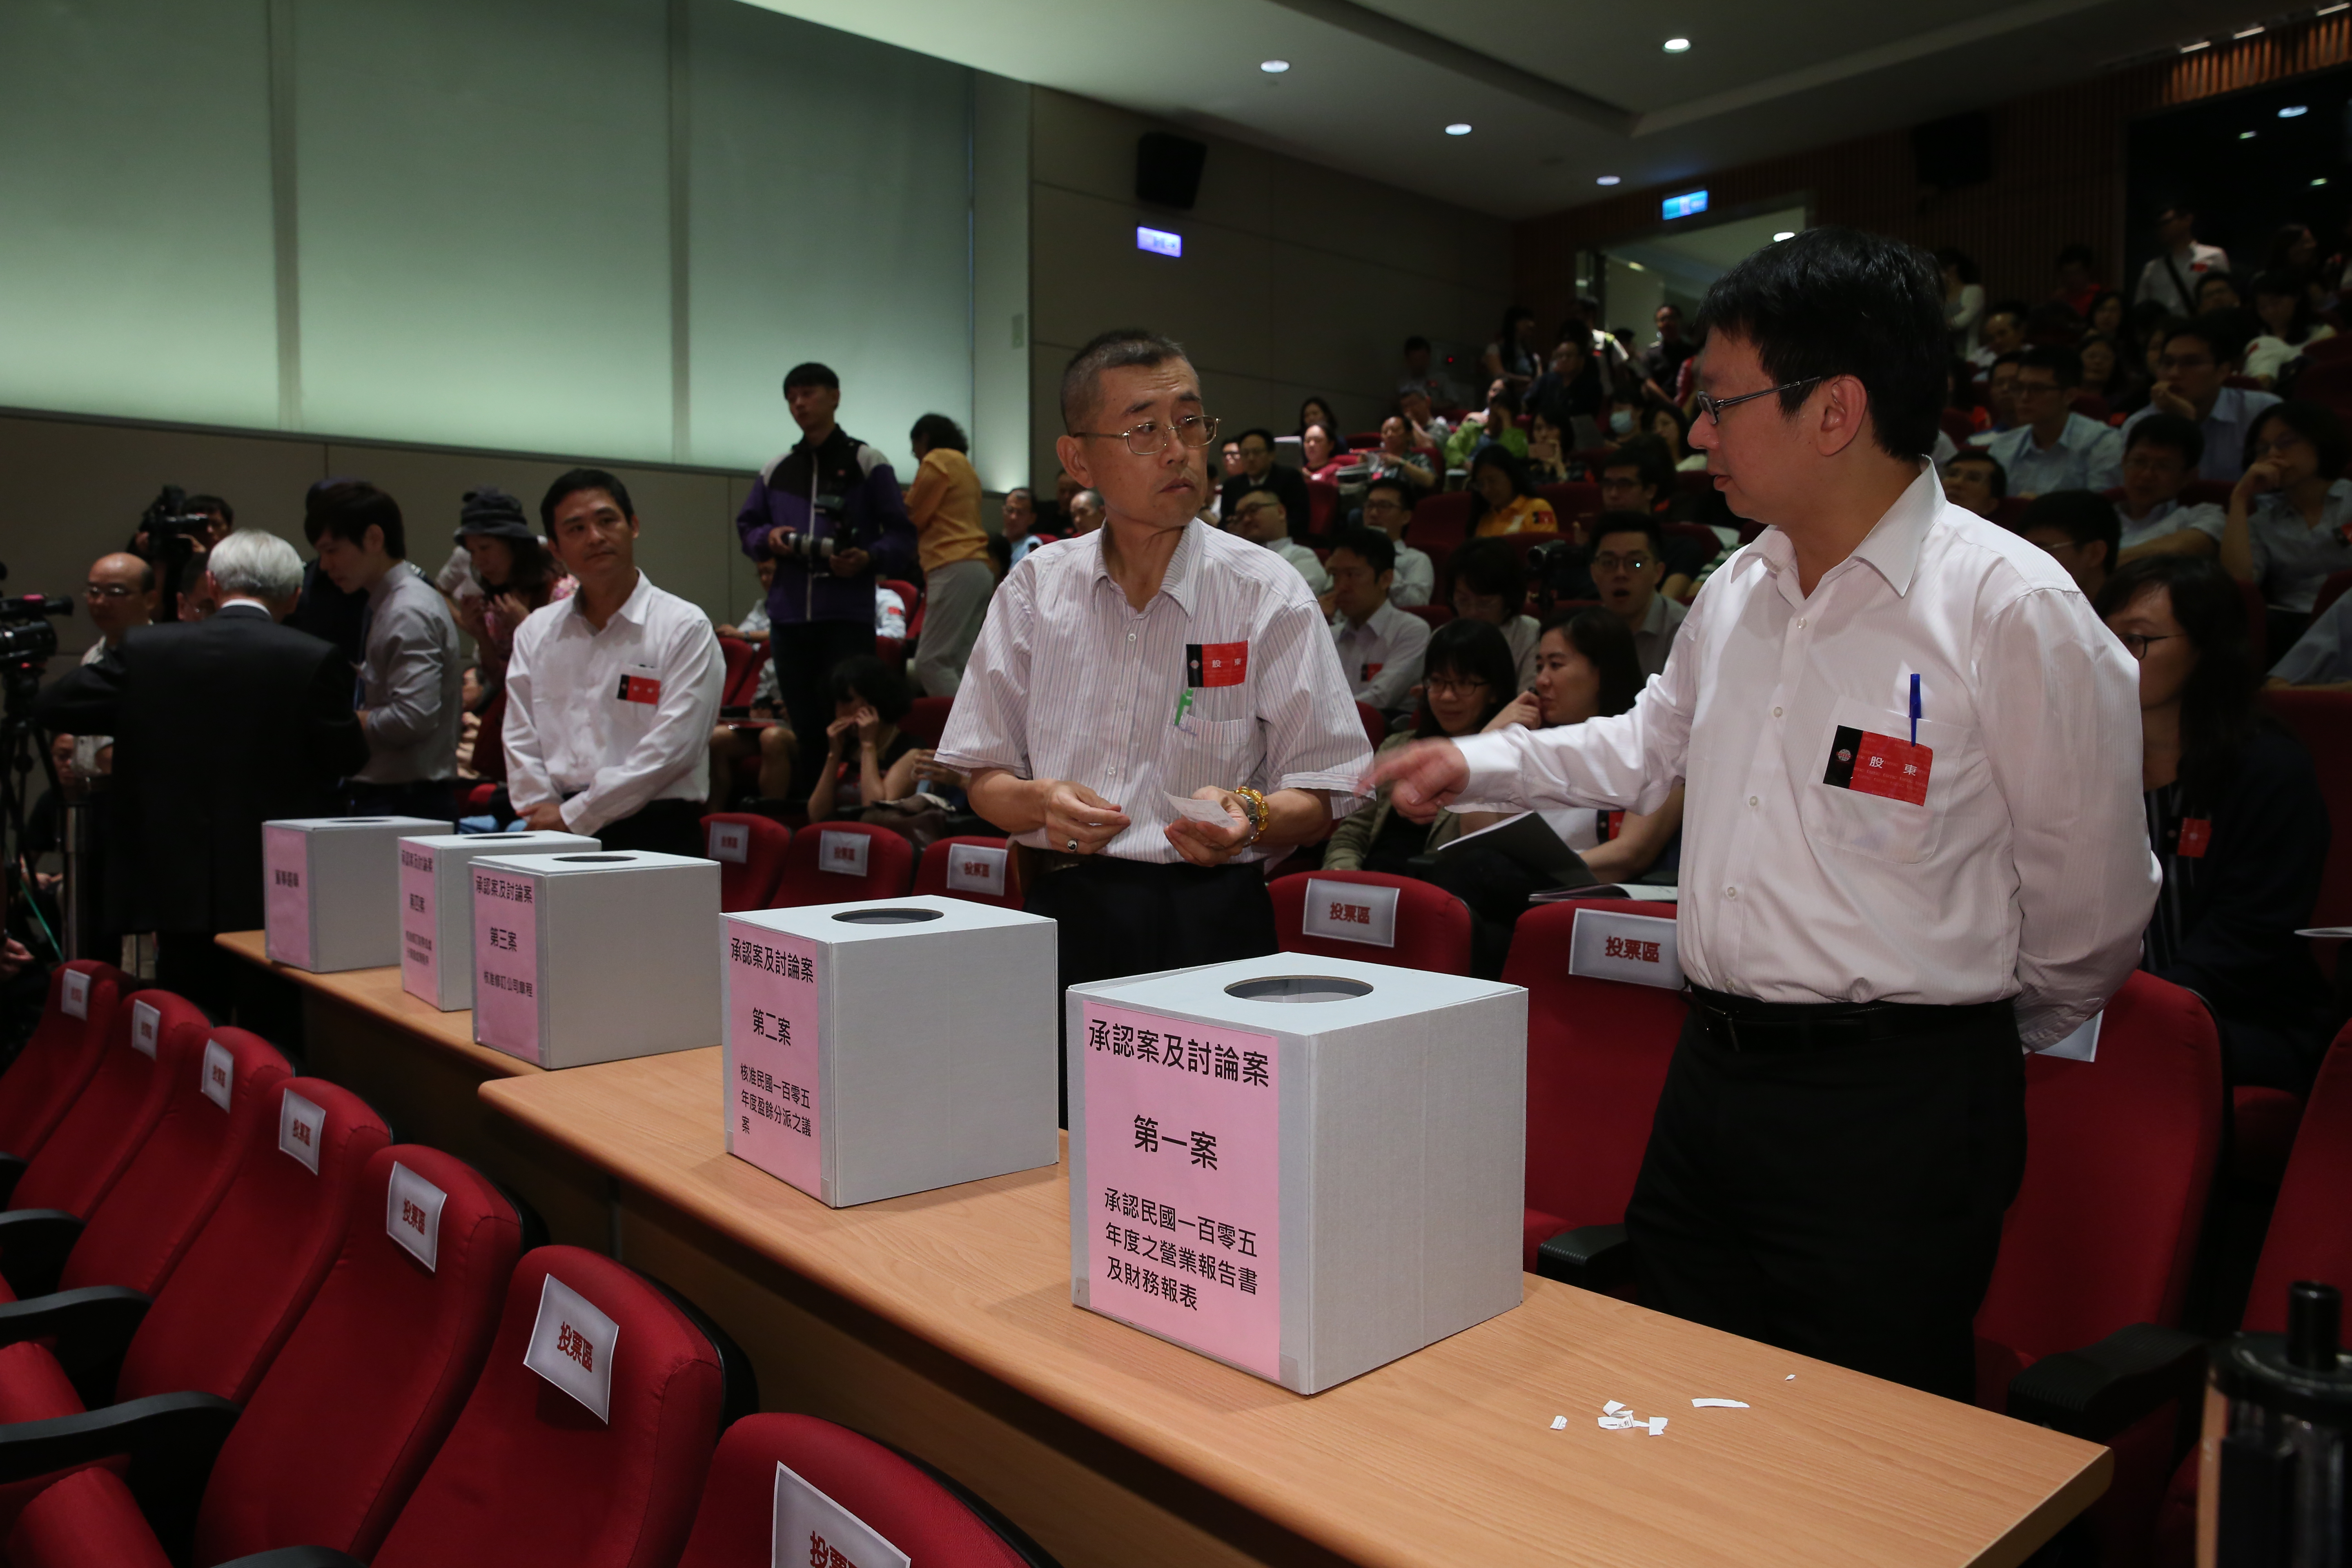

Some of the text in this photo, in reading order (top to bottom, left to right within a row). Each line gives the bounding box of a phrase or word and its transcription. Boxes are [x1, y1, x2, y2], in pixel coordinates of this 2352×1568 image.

[1869, 756, 1918, 776] 股東
[1330, 903, 1370, 924] 投票區
[491, 927, 517, 952] 第三案
[731, 938, 813, 983] 承認案及討論案
[1605, 937, 1660, 963] 投票區
[753, 1007, 791, 1046] 第二案
[1089, 1019, 1269, 1087] 承認案及討論案
[740, 1063, 810, 1109] 核准民國一百零五
[741, 1089, 811, 1137] 年度盈餘分派之議
[742, 1116, 750, 1134] 案
[1134, 1114, 1217, 1171] 第一案
[403, 1200, 426, 1235] 投票區
[1105, 1187, 1257, 1257] 承認民國一百零五
[1106, 1222, 1257, 1295] 年度之營業報告書
[1107, 1256, 1197, 1311] 及財務報表
[557, 1321, 594, 1372] 投票區
